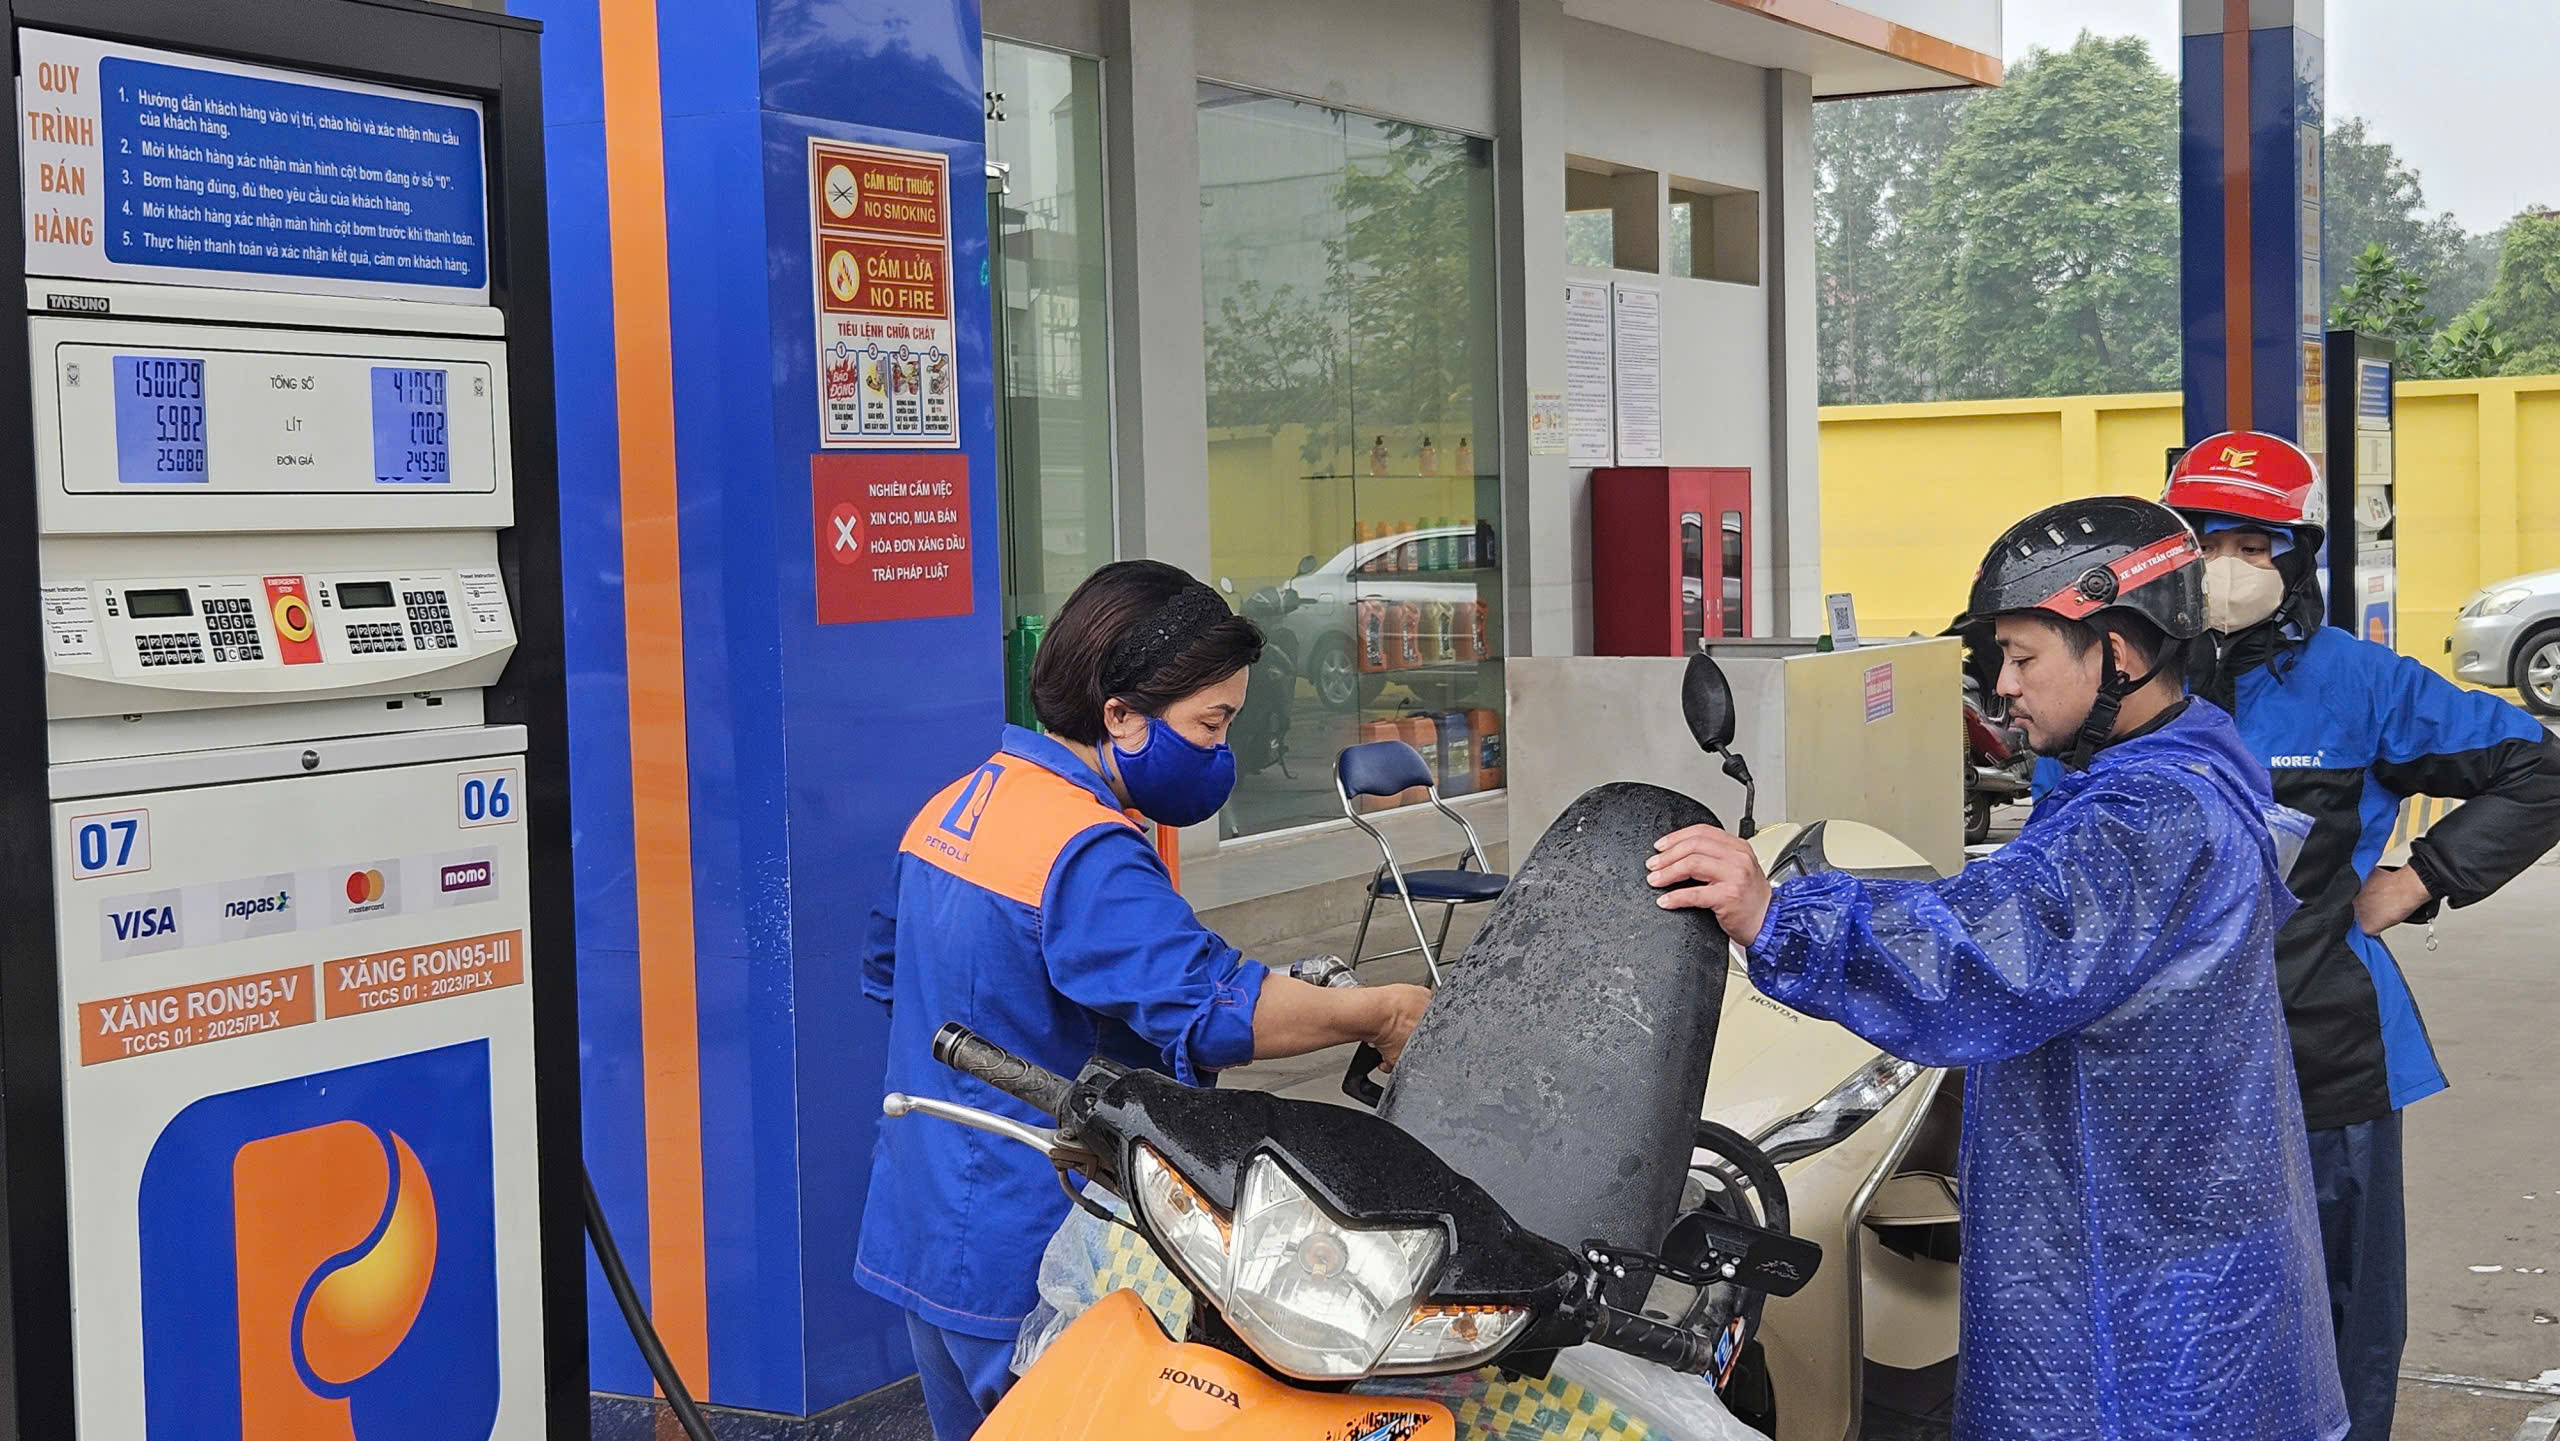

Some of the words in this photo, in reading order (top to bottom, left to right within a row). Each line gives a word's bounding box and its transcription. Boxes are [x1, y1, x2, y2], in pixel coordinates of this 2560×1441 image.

[38, 62, 80, 95] QUY
[28, 107, 94, 146] TRÌNH
[119, 86, 129, 102] 1.
[138, 89, 178, 112] Hướng
[181, 93, 202, 112] dẫn
[204, 98, 238, 117] khách
[240, 104, 266, 124] hàng
[270, 110, 288, 124] vào
[291, 111, 300, 128] vị
[302, 112, 317, 130] trí,
[319, 116, 344, 131] chào
[346, 118, 362, 133] hỏi
[364, 120, 376, 135] và
[378, 122, 394, 137] xác
[397, 125, 420, 143] nhận
[422, 128, 440, 144] nhu
[442, 128, 460, 146] cầu
[140, 110, 160, 127] của
[164, 112, 198, 132] khách
[200, 118, 230, 138] hàng.
[120, 138, 132, 154] 2.
[142, 140, 164, 157] Mời
[168, 144, 202, 162] khách
[206, 148, 234, 169] hàng
[237, 152, 256, 168] xác
[259, 155, 286, 174] nhận
[289, 160, 312, 175] màn
[315, 161, 338, 177] hình
[341, 165, 357, 181] cột
[359, 166, 382, 182] bơm
[386, 170, 410, 188] đang
[412, 172, 420, 186] ở
[422, 170, 434, 188] số
[40, 159, 86, 196] BÁN
[864, 168, 885, 190] CẤM
[887, 173, 904, 192] HÚT
[907, 174, 934, 196] THUỐC
[122, 170, 133, 185] 3.
[144, 171, 172, 188] Bơm
[176, 175, 204, 195] hàng
[208, 179, 240, 198] đúng,
[242, 181, 256, 198] đủ
[259, 185, 283, 200] theo
[287, 187, 305, 204] yêu
[308, 186, 327, 204] cầu
[331, 192, 349, 206] của
[352, 194, 383, 210] khách
[386, 197, 413, 215] hàng.
[123, 200, 133, 216] 4.
[143, 202, 164, 218] Mời
[168, 204, 201, 222] khách
[204, 207, 231, 228] hàng
[234, 211, 253, 226] xác
[256, 214, 282, 232] nhận
[285, 217, 307, 231] màn
[310, 218, 332, 233] hình
[334, 221, 351, 238] cột
[354, 222, 376, 237] bơm
[379, 225, 406, 240] trước
[408, 228, 423, 241] khi
[425, 228, 450, 243] thanh
[453, 232, 475, 246] toán.
[864, 201, 881, 218] NO
[884, 204, 936, 223] SMOKING
[34, 208, 94, 246] HÀNG
[123, 232, 133, 246] 5.
[144, 233, 174, 252] Thực
[177, 235, 200, 254] hiện
[204, 237, 236, 254] thanh
[239, 240, 262, 256] toán
[266, 242, 278, 257] và
[281, 244, 299, 259] xác
[302, 246, 328, 264] nhận
[331, 245, 347, 262] kết
[350, 250, 372, 266] quả,
[374, 252, 395, 266] cảm
[398, 256, 411, 267] ơn
[414, 255, 443, 270] khách
[445, 258, 471, 275] hàng.
[867, 250, 900, 278] CẤM
[905, 254, 933, 281] LỬA
[50, 296, 108, 310] TATSUNO
[871, 287, 894, 308] NO
[899, 289, 934, 310] FIRE
[840, 345, 843, 355] 1
[871, 347, 875, 355] 2
[902, 348, 906, 357] 3
[932, 350, 936, 358] 4
[136, 360, 200, 398] 150029
[270, 374, 297, 390] TỔNG
[301, 374, 315, 391] SỐ
[394, 372, 443, 405] 41750
[832, 369, 848, 382] BÁO
[830, 382, 855, 401] ĐỘNG
[286, 416, 302, 432] LÍT
[157, 448, 204, 472] 25080
[276, 453, 294, 466] ĐƠN
[295, 453, 314, 466] GIÁ
[407, 451, 445, 472] 24530
[869, 481, 907, 497] NGHIÊM
[909, 480, 930, 496] CẤM
[932, 480, 952, 499] VIỆC
[870, 512, 886, 525] XIN
[888, 511, 912, 526] CHO,
[914, 511, 935, 523] MUA
[937, 508, 957, 522] BÁN
[870, 538, 892, 553] HÓA
[894, 538, 916, 552] ĐƠN
[918, 537, 944, 551] XĂNG
[947, 534, 965, 550] DẦU
[872, 566, 895, 581] TRÁI
[897, 564, 922, 580] PHÁP
[925, 562, 949, 582] LUẬT
[2119, 570, 2131, 581] XE
[2130, 562, 2148, 575] MÁY
[2271, 752, 2321, 767] KOREA
[464, 778, 510, 821] 06
[80, 820, 138, 871] 07
[445, 869, 486, 885] momo
[225, 896, 274, 920] napas
[348, 903, 385, 914] mastercard
[107, 906, 176, 941] VISA
[339, 958, 406, 992] XĂNG
[412, 938, 511, 978] RON95-III
[360, 990, 400, 1009] TCCS
[403, 986, 418, 1002] 01
[431, 970, 493, 996] 2023/PLX
[100, 996, 178, 1036] XĂNG
[187, 975, 298, 1019] RON95-V
[1748, 994, 1800, 1023] HONDA
[122, 1034, 170, 1055] TCCS
[175, 1028, 192, 1047] 01
[208, 1011, 281, 1039] 2025/PLX
[1159, 1367, 1241, 1410] HONDA
